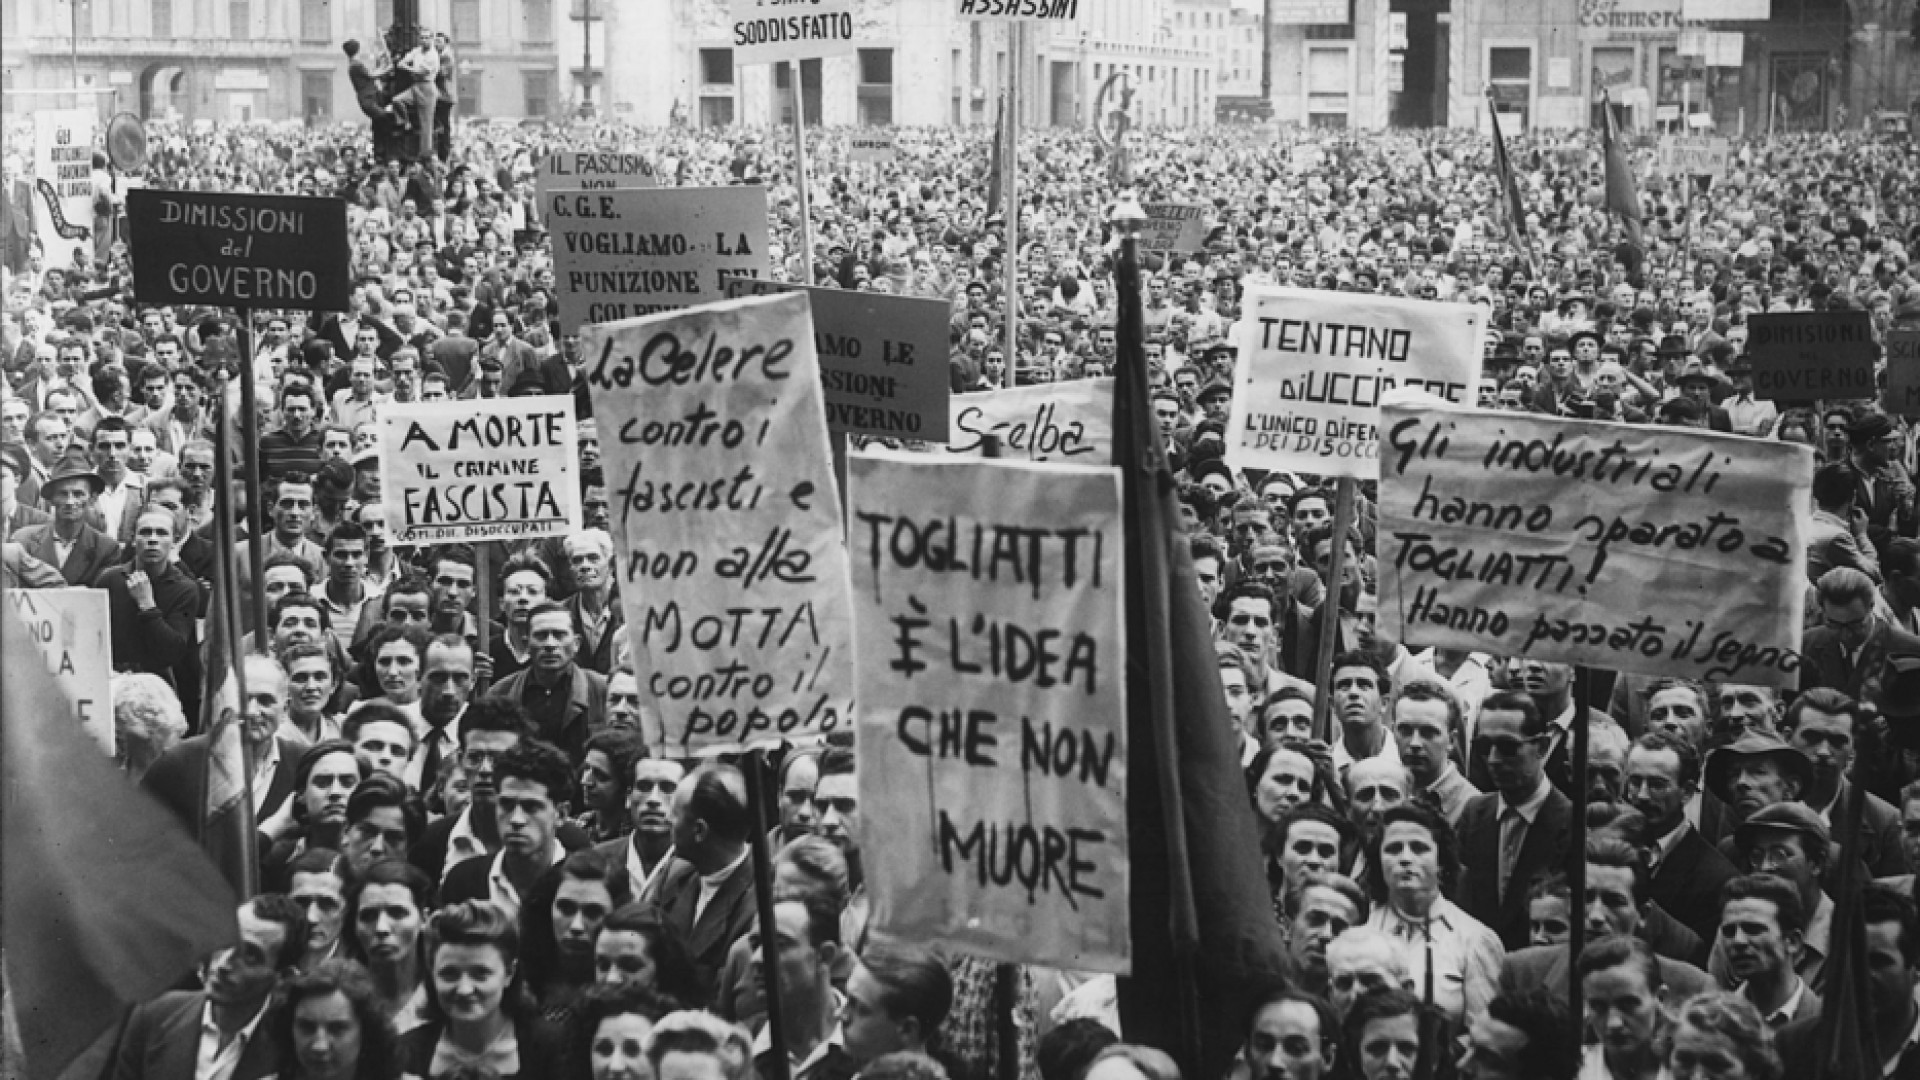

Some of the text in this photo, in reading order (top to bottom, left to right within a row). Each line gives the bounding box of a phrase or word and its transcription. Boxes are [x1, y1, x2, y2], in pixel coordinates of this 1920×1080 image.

[734, 11, 852, 45] SODDISFATTO
[550, 154, 654, 177] IL FASCISMO
[160, 200, 303, 235] DIMISSIONI
[219, 234, 254, 258] del
[564, 231, 753, 256] VOGLIAMO LA
[168, 262, 317, 300] GOVERNO
[568, 271, 701, 293] PUNIZIONE
[639, 331, 795, 387] Celere
[882, 339, 915, 366] LE
[1258, 316, 1412, 362] TENTANO
[400, 411, 566, 451] A MORTE
[1254, 433, 1289, 452] DEI
[416, 458, 540, 480] IL CRIMINE
[1389, 417, 1731, 493] Gli industriali
[404, 481, 562, 526] FASCISTA
[616, 460, 816, 523] fascisti e
[1412, 474, 1553, 533] hanno
[1573, 511, 1746, 572] sparato
[628, 549, 698, 583] non
[856, 506, 1104, 596] TOGLIATTI
[643, 600, 820, 653] MOTTA
[1406, 584, 1511, 638] Hanno
[1520, 613, 1667, 655] passato
[1670, 618, 1706, 661] il
[890, 595, 1098, 697] È L'IDEA
[650, 646, 831, 700] contro il
[897, 705, 1116, 788] CHE NON
[938, 808, 1107, 911] MUORE
